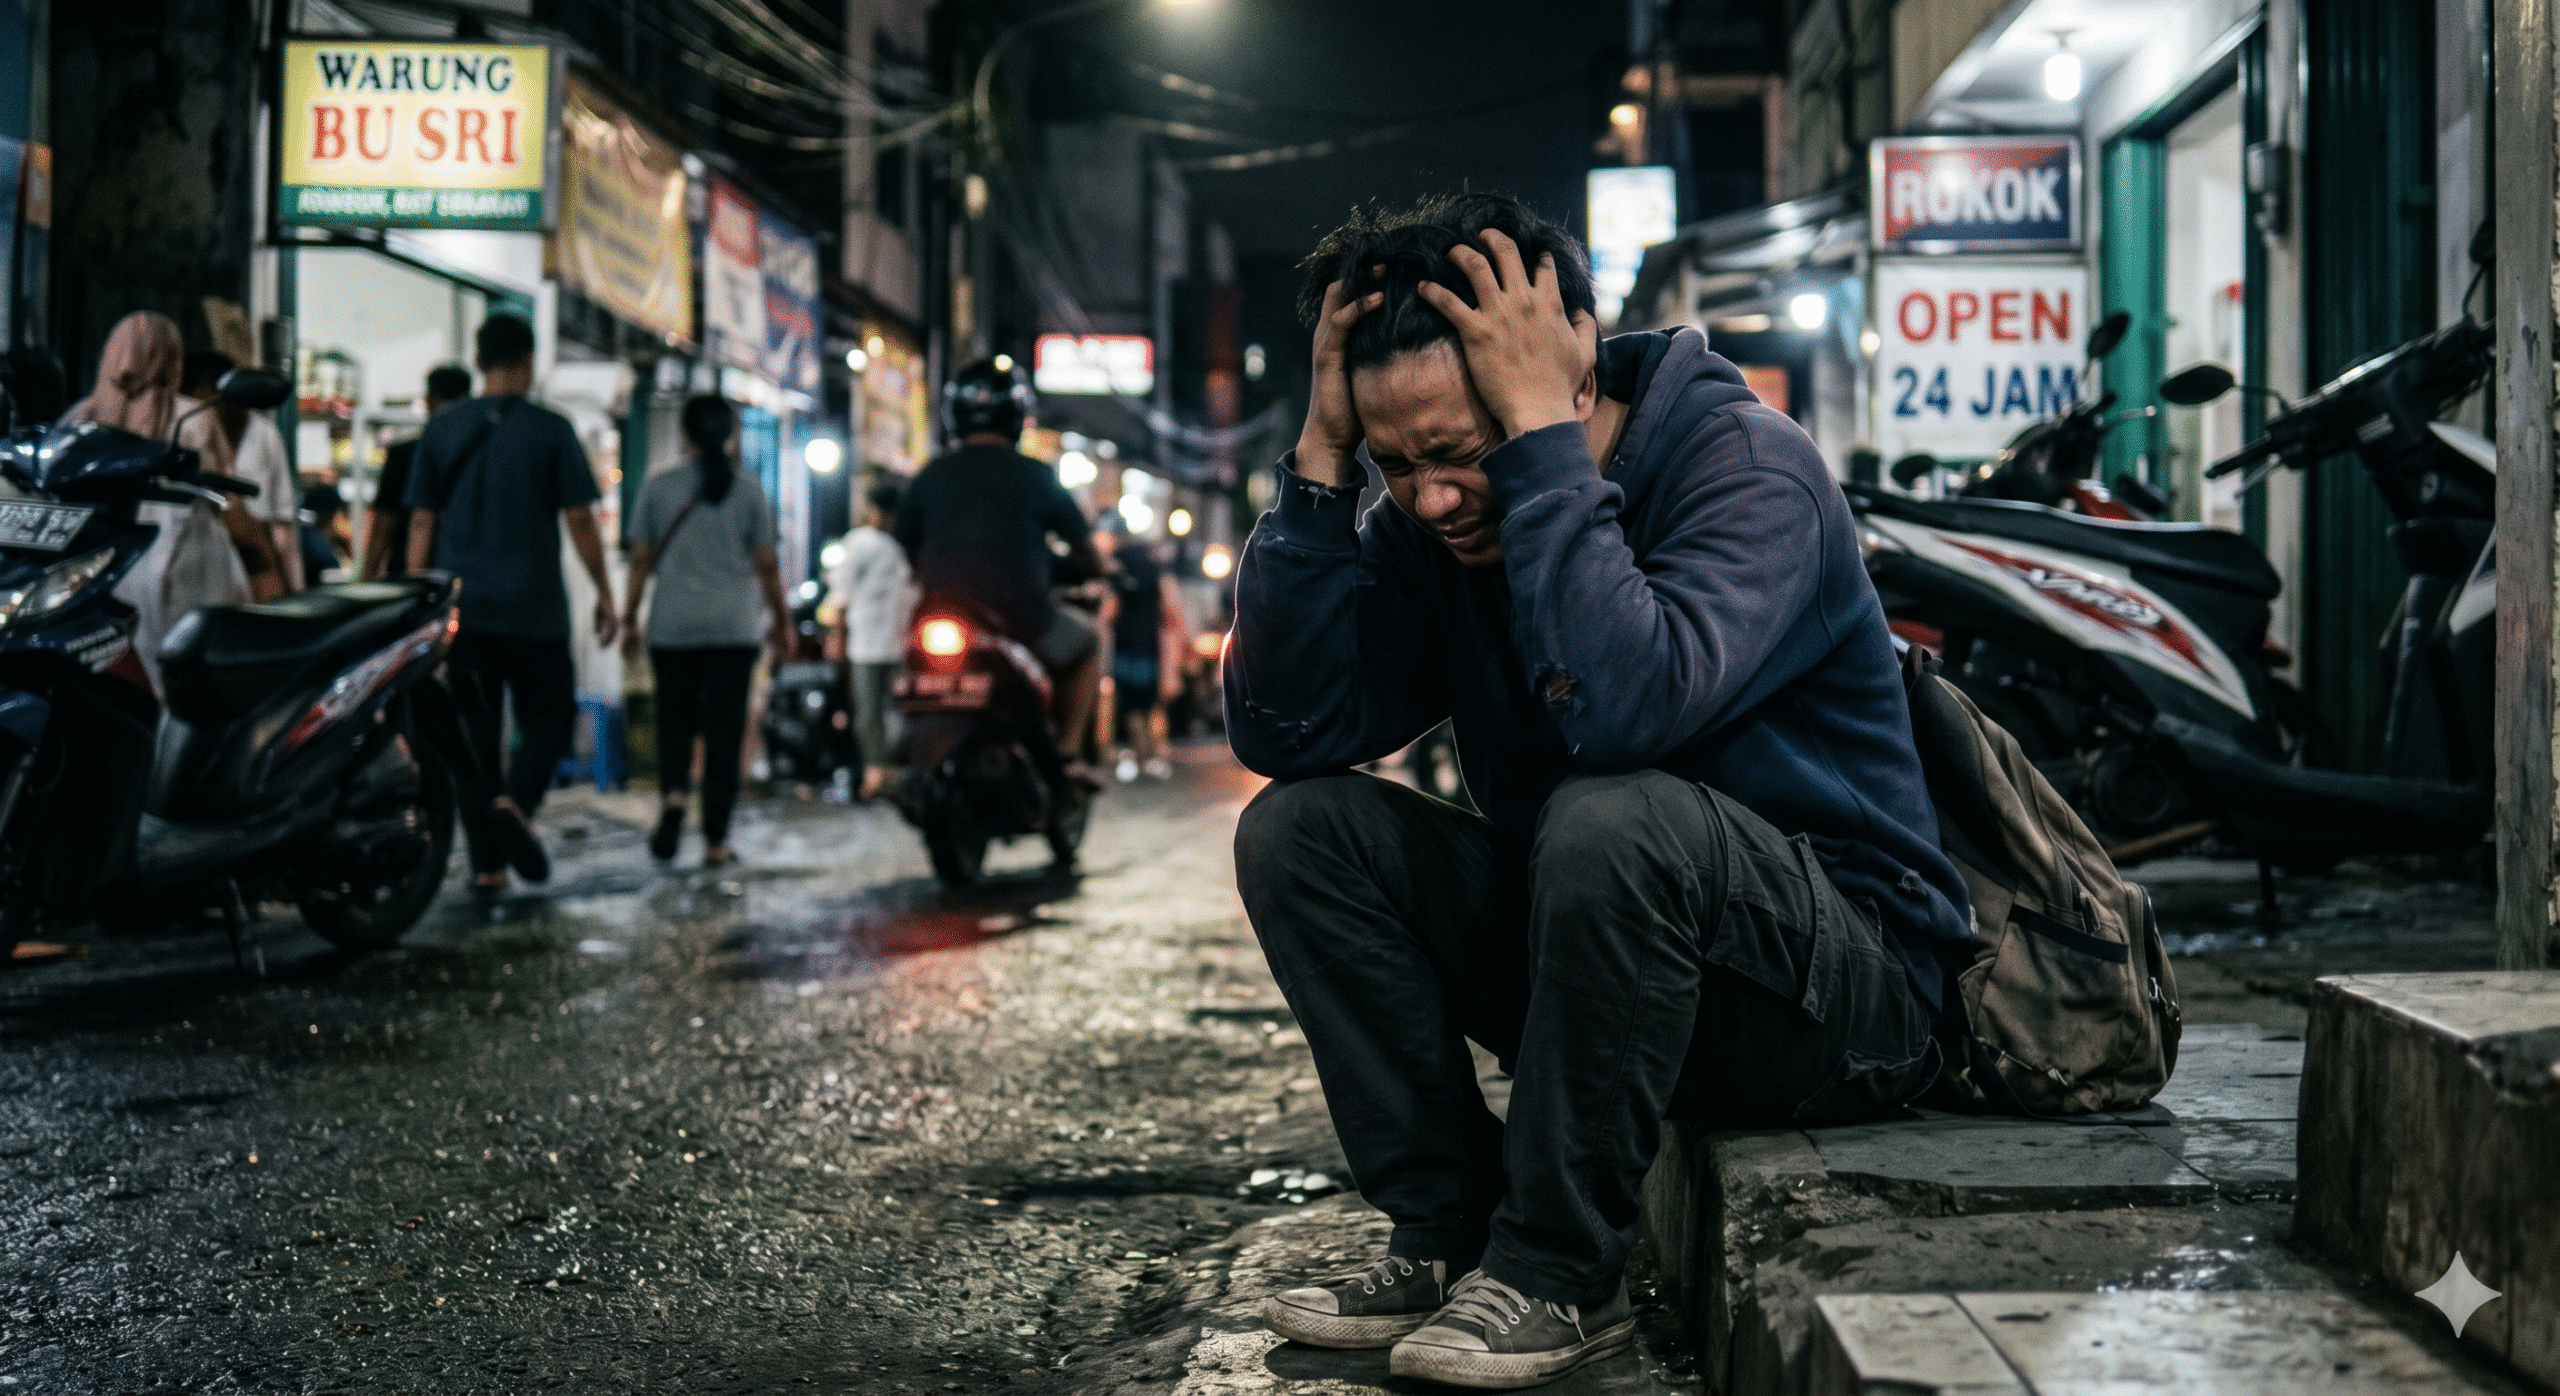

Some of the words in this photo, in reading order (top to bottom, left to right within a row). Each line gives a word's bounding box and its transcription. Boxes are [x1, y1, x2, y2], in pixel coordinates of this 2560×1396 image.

[318, 53, 512, 92] WARUNG
[312, 105, 394, 162] BU
[415, 106, 519, 164] SRI
[1892, 166, 2061, 224] ROKOK
[1897, 290, 2071, 342] OPEN
[1893, 365, 1950, 418] 24
[1970, 365, 2079, 420] JAM
